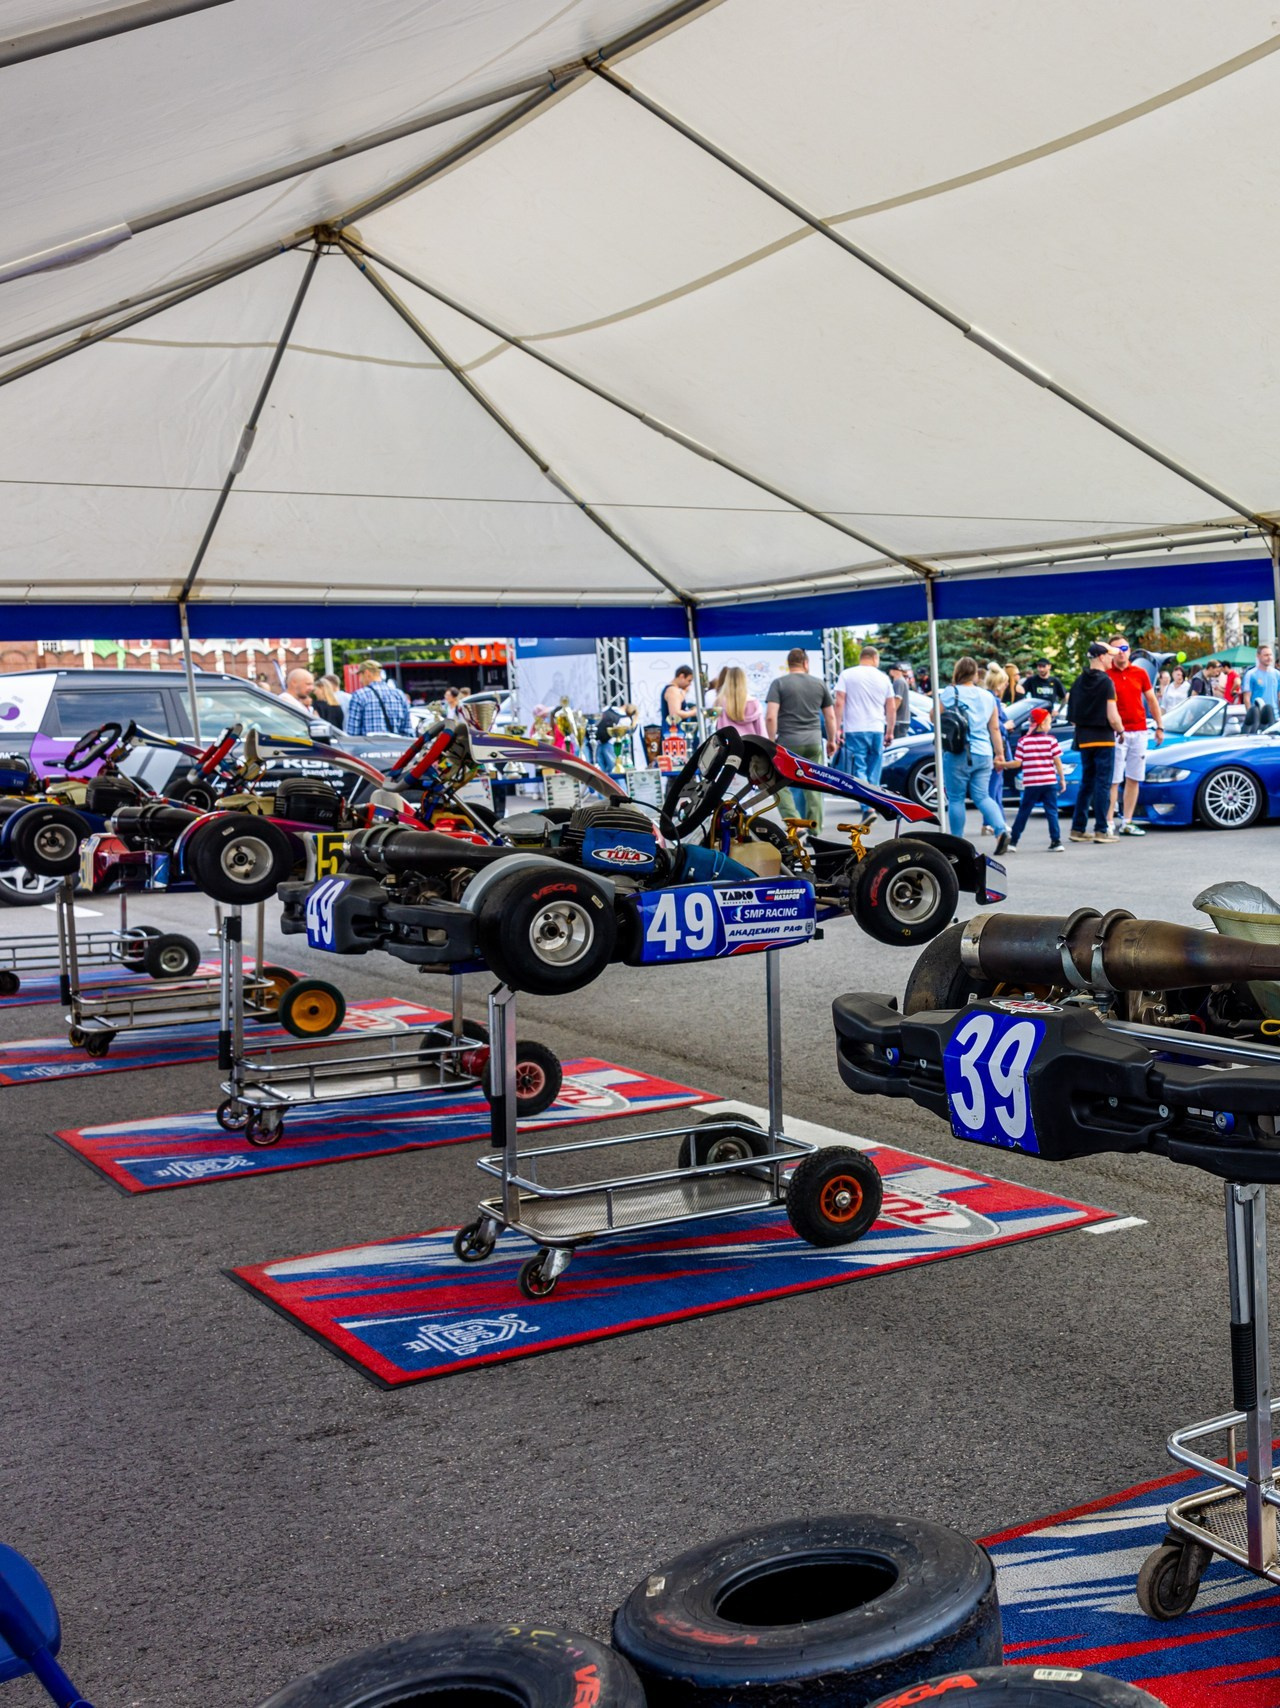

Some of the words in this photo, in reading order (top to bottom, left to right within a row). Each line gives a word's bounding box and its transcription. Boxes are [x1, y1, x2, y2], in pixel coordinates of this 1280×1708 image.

[450, 642, 508, 665] aut
[607, 850, 641, 861] TULA
[532, 883, 578, 900] VEGA
[719, 890, 754, 901] YADRO
[870, 867, 889, 907] VEGA
[307, 879, 345, 945] 49
[646, 892, 714, 953] 49
[744, 908, 765, 919] SMP
[765, 907, 798, 918] RACING
[728, 926, 780, 937] АКАДЕМИЯ
[783, 925, 803, 933] РАФ
[951, 1014, 1036, 1139] 39
[573, 1664, 601, 1708] VE
